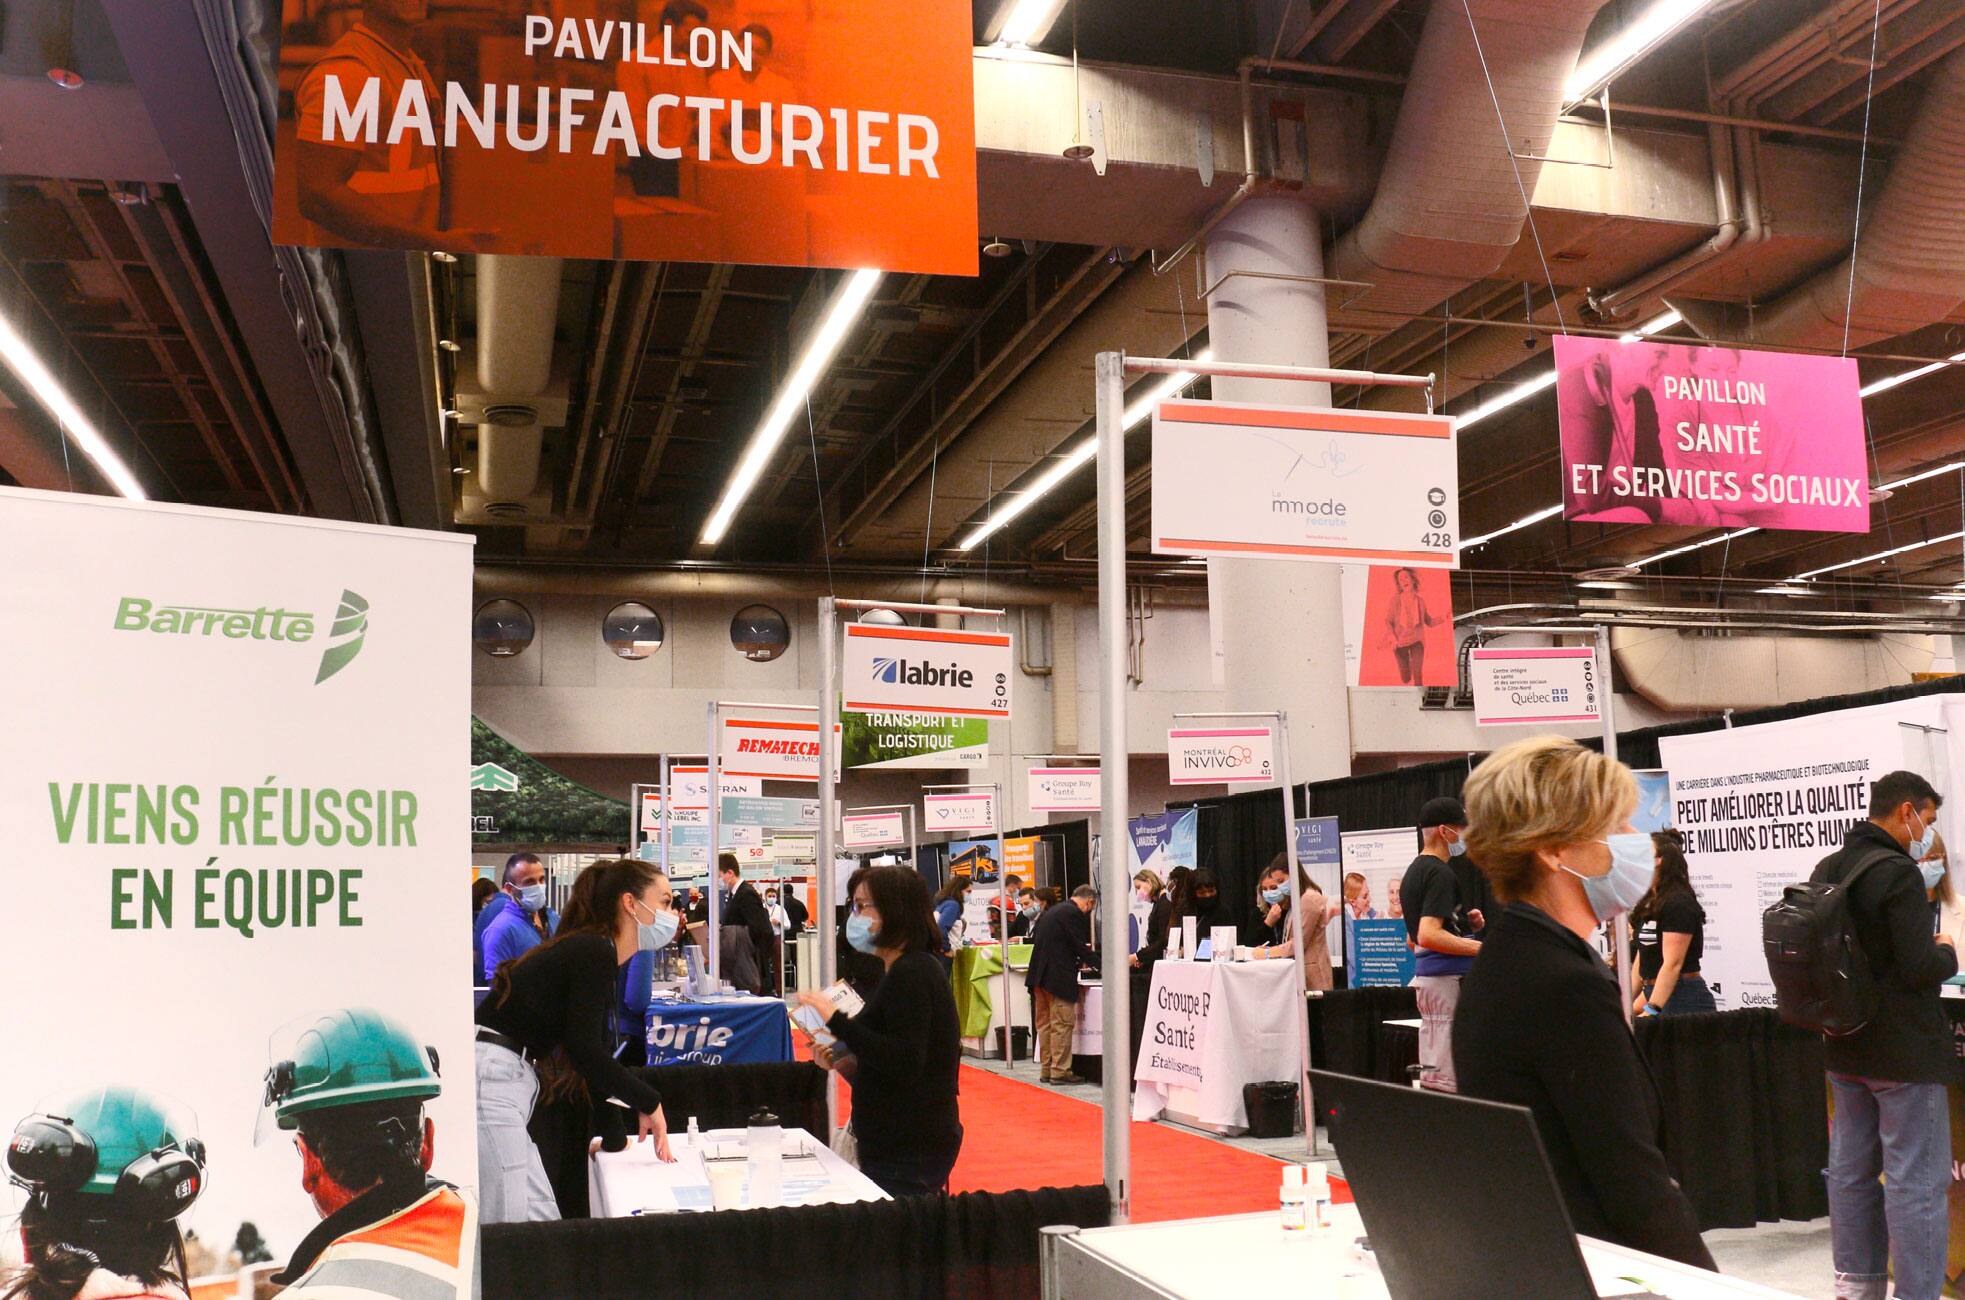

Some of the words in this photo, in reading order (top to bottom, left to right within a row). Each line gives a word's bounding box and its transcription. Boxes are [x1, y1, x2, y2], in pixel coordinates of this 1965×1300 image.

[525, 15, 754, 72] PAVILLON
[321, 74, 940, 179] MANUFACTURIER
[1664, 376, 1766, 406] PAVILLON
[1677, 420, 1762, 455] SANTÉ
[1572, 464, 1602, 495] ET
[1613, 466, 1742, 502] SERVICES
[1752, 473, 1862, 507] SOCIAUX
[1421, 533, 1451, 548] 428
[113, 597, 315, 643] Barrette
[900, 659, 973, 688] labrie
[991, 699, 1008, 708] 427
[1511, 691, 1550, 706] Québec
[1585, 704, 1597, 712] 431
[866, 713, 945, 728] TRANSPORT
[952, 716, 965, 728] ET
[737, 738, 820, 755] REMATECH
[878, 734, 955, 750] LOGISTIQUE
[1183, 748, 1227, 756] MONTRÉAL
[700, 785, 747, 793] SFRAN
[1053, 780, 1077, 788] Groupe
[1676, 781, 1685, 790] UNE
[1710, 777, 1723, 788] DANS
[1755, 767, 1803, 782] PHARMACEUTIQUE
[1804, 766, 1811, 777] ET
[1812, 759, 1869, 777] BIOTECHNOLOGIQUE
[48, 782, 200, 845] VIENS
[219, 775, 418, 847] RÉUSSIR
[1677, 799, 1707, 824] PEUT
[1711, 790, 1784, 822] AMÉLIORER
[1787, 789, 1804, 816] LA
[1807, 776, 1867, 815] QUALITÉ
[1301, 825, 1321, 834] VIGI
[1681, 830, 1695, 854] DE
[1698, 826, 1756, 854] MILLIONS
[1759, 818, 1815, 850] D'ÊTRES
[1818, 817, 1869, 847] HUM
[111, 868, 173, 930] EN
[194, 856, 363, 938] ÉQUIPE
[1158, 985, 1200, 1021] Groupe
[1742, 992, 1772, 1005] Québec
[646, 1015, 733, 1050] brie
[1154, 1021, 1195, 1051] Santé
